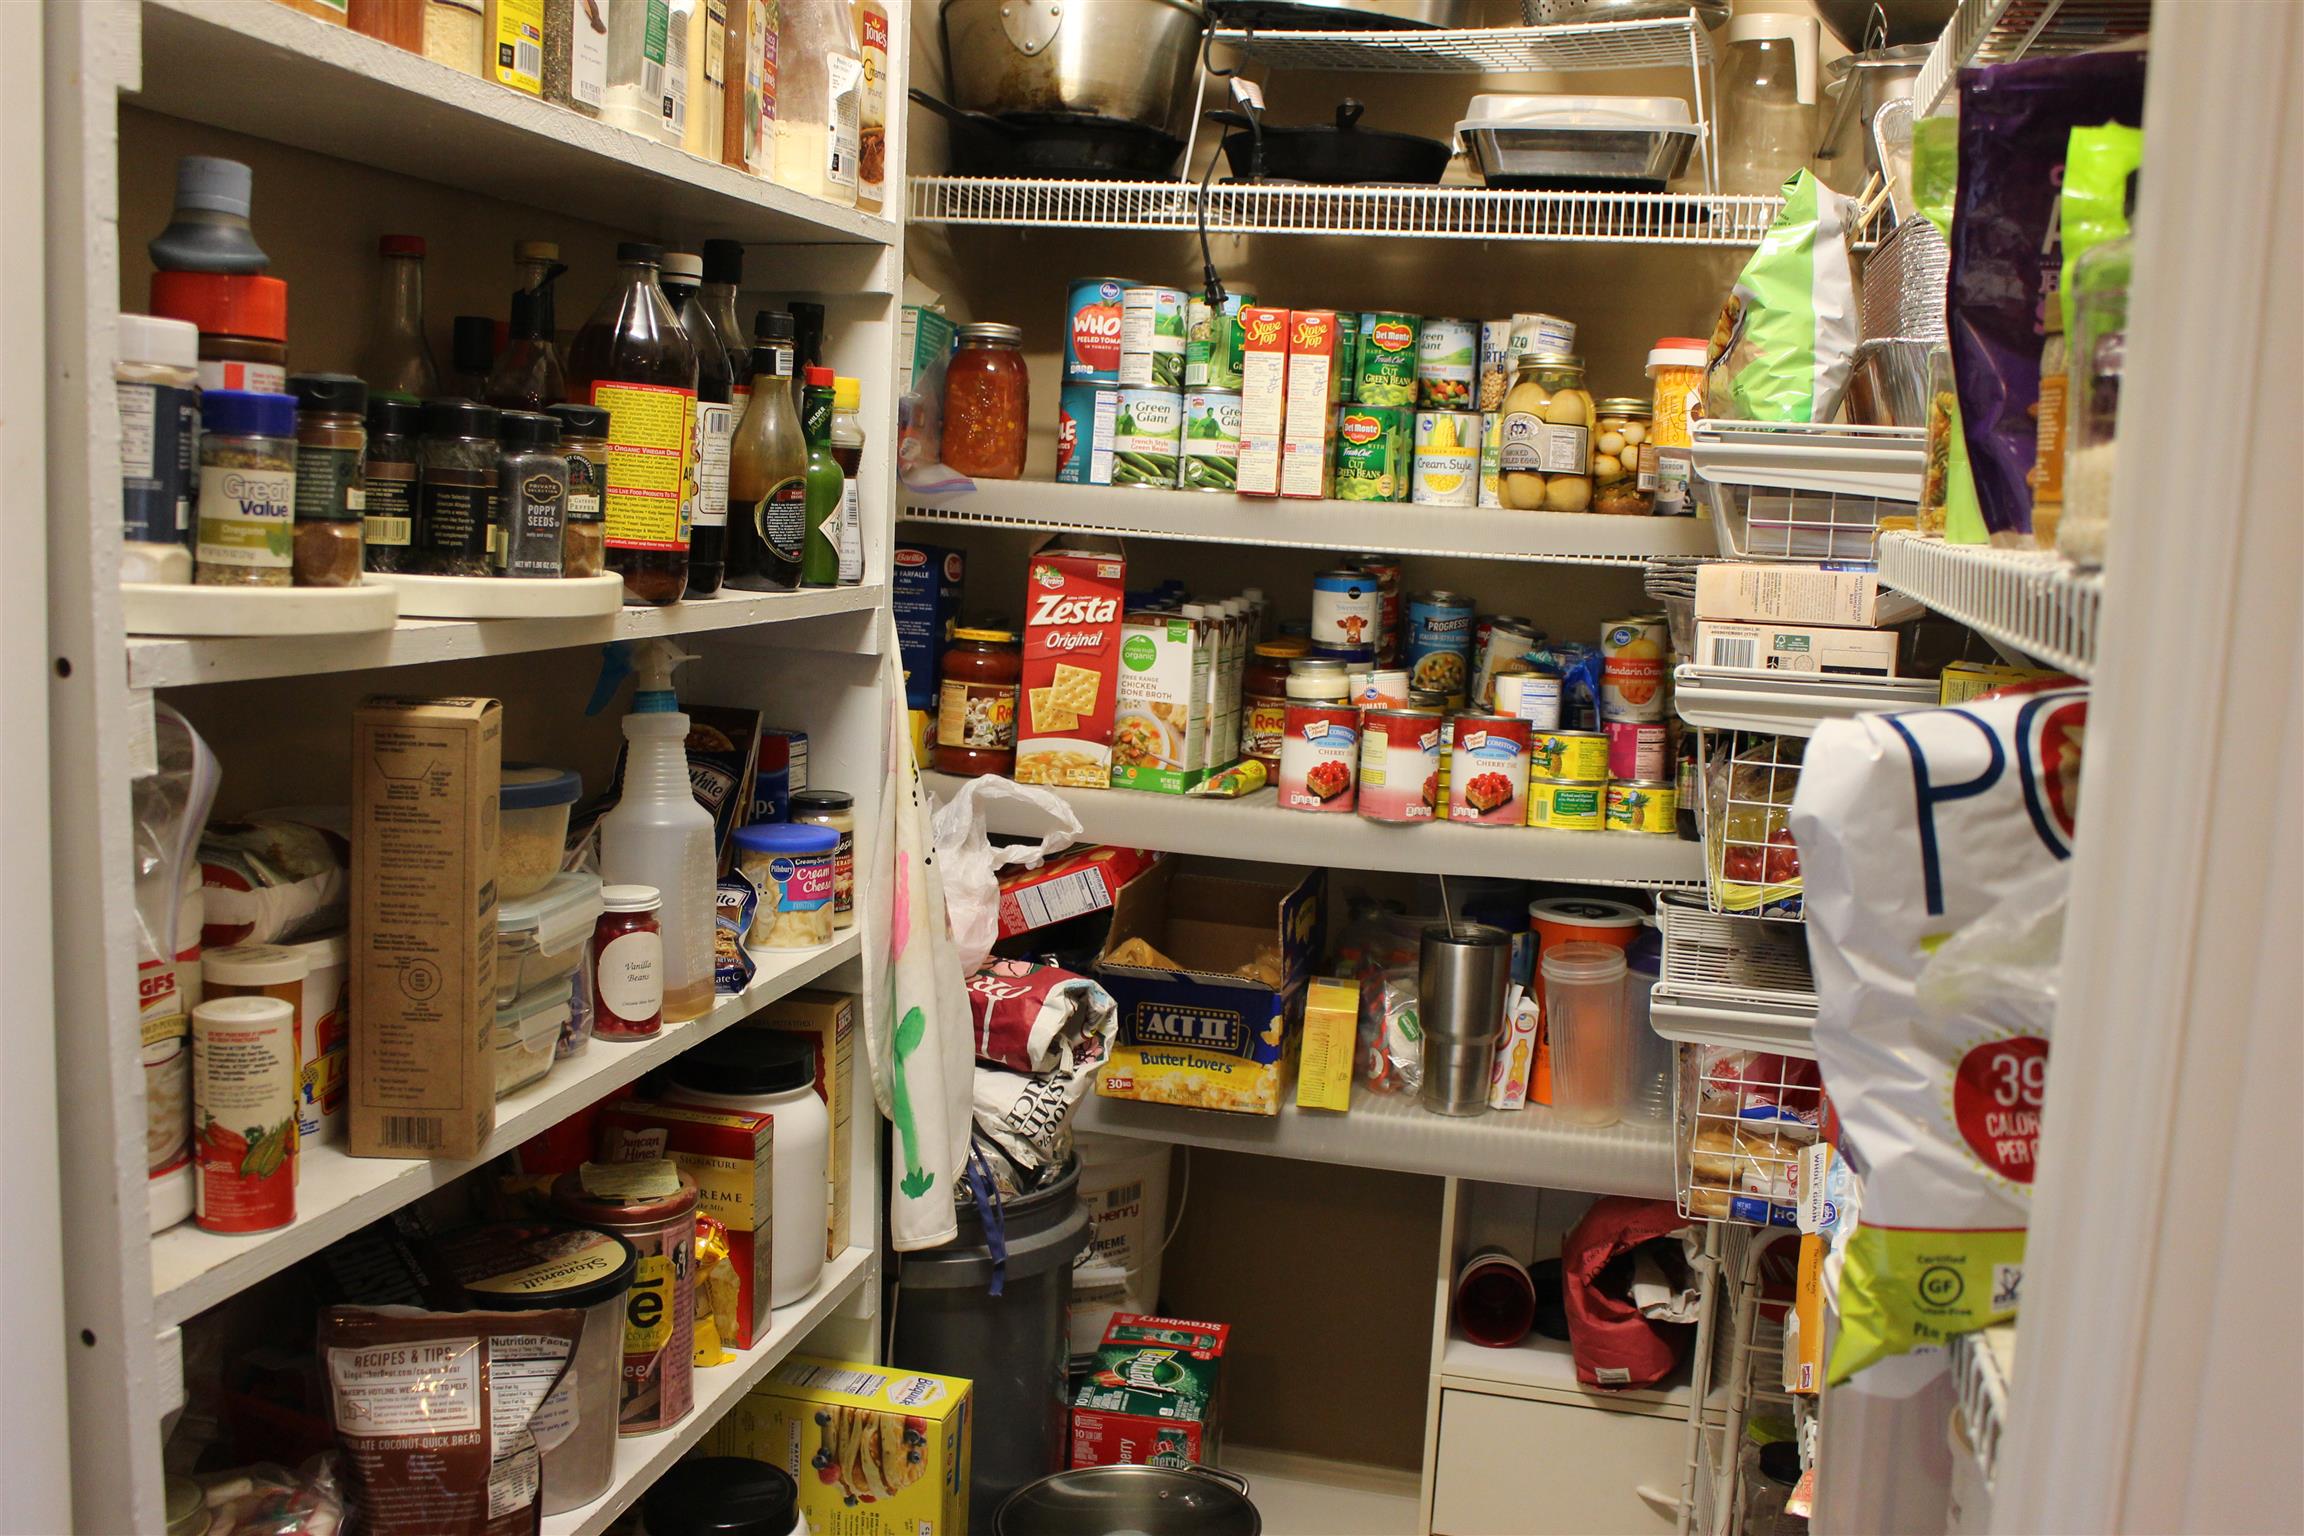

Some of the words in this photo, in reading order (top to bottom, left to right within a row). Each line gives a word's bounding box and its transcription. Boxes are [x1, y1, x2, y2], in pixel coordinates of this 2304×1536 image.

[865, 22, 887, 48] Tone's
[864, 59, 886, 81] Cinnamon
[1248, 320, 1282, 340] Stove
[1294, 323, 1328, 343] Stove
[1375, 330, 1389, 339] Del
[1390, 331, 1410, 341] Monte
[1077, 336, 1100, 344] PEELED
[1260, 333, 1277, 345] Top
[1304, 336, 1322, 348] Top
[1421, 333, 1444, 341] reen
[1381, 367, 1398, 376] CUT
[1365, 374, 1389, 383] GREEN
[1390, 375, 1410, 384] BEANS
[1136, 402, 1171, 413] Green
[807, 406, 826, 425] MILDER
[1137, 412, 1168, 424] Giant
[1344, 423, 1354, 433] Del
[1355, 424, 1378, 434] Monte
[1348, 460, 1365, 469] CUT
[1418, 459, 1446, 469] Cream
[1449, 460, 1472, 471] Style
[1356, 469, 1381, 479] BEANS
[223, 473, 290, 500] Great
[240, 500, 289, 517] Value
[528, 504, 556, 517] POPPY
[527, 515, 554, 528] SEEDS
[220, 525, 267, 537] Oregano
[897, 554, 924, 562] Barilla
[1029, 594, 1118, 625] Zesta
[1046, 632, 1101, 650] Original
[1125, 652, 1154, 660] organic
[1605, 665, 1642, 676] Mandarin
[1122, 681, 1157, 690] CHICKEN
[1121, 689, 1143, 697] BONE
[1146, 690, 1172, 699] BROTH
[689, 766, 725, 799] White
[771, 865, 793, 874] Pillsbury
[797, 868, 830, 880] Cream
[803, 880, 831, 893] Cheese
[624, 960, 652, 972] Vanilla
[140, 972, 175, 996] GFS
[627, 972, 650, 983] Beans
[1147, 1013, 1195, 1037] ACT
[1200, 1018, 1228, 1041] II
[1140, 1051, 1185, 1066] Butter
[1188, 1055, 1233, 1074] Lovers
[1108, 1079, 1122, 1089] 30
[1985, 1112, 2041, 1138] CALOR
[622, 1134, 660, 1150] Duncan
[624, 1147, 657, 1161] Hines
[1996, 1141, 2029, 1165] PER
[679, 1154, 737, 1171] SIGNATURE
[1812, 1153, 1820, 1190] WHOLE
[699, 1189, 743, 1204] REME
[1099, 1203, 1139, 1222] Henry
[1917, 1255, 1966, 1264] Certified
[524, 1257, 608, 1290] Stonemill
[1930, 1279, 1953, 1293] GF
[1139, 1315, 1222, 1331] Strawberry
[491, 1338, 537, 1346] Nutrition
[540, 1337, 568, 1346] Facts
[354, 1351, 405, 1368] RECIPES
[411, 1350, 418, 1362] &
[424, 1347, 452, 1362] TIPS
[451, 1383, 469, 1391] HELP.
[899, 1377, 934, 1406] Bisquick
[1075, 1429, 1085, 1438] 10
[379, 1436, 418, 1451] COCONUT
[422, 1437, 449, 1449] QUICK
[452, 1434, 481, 1446] BREAD
